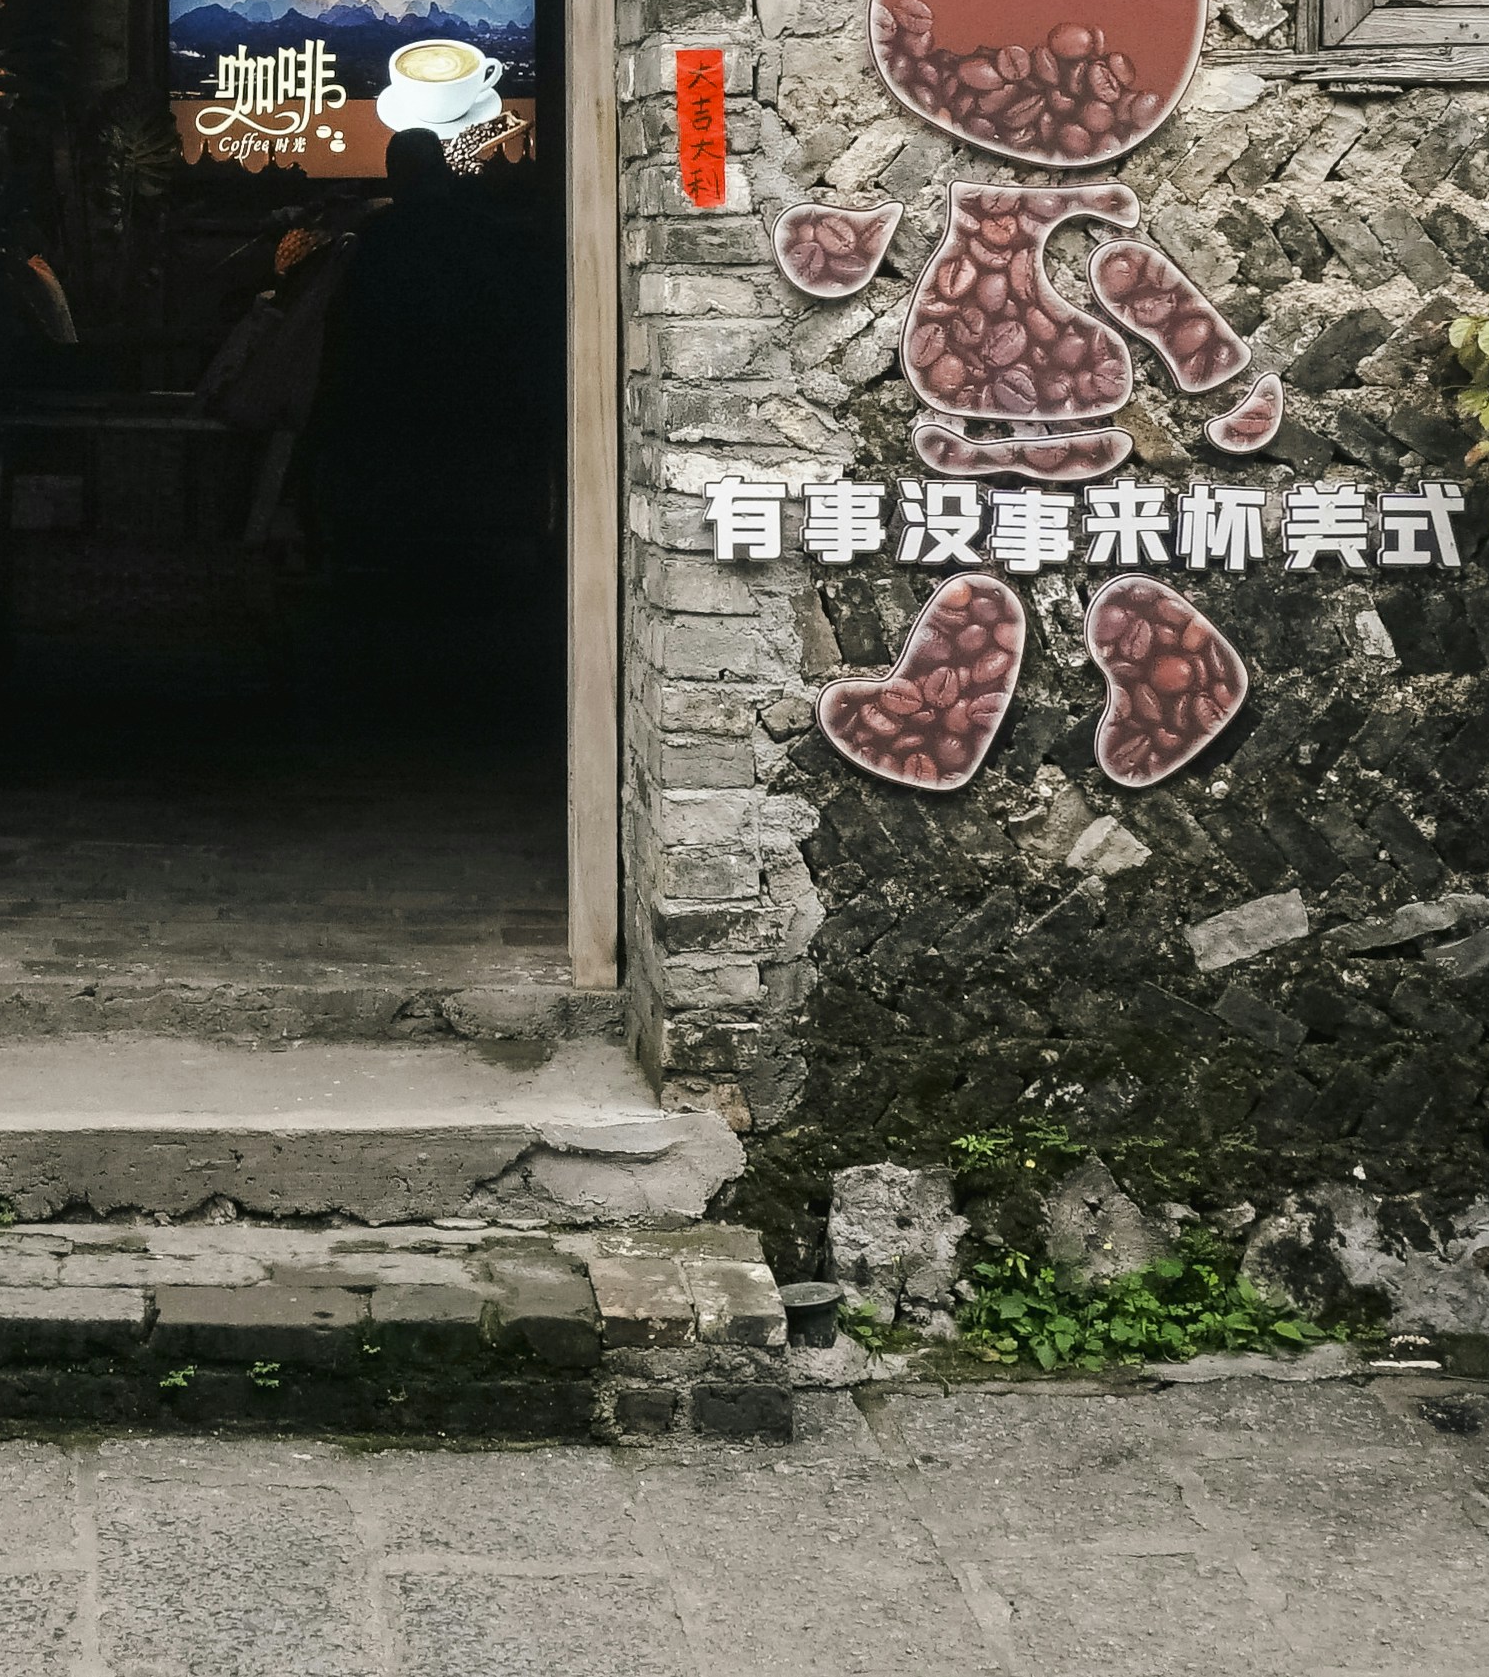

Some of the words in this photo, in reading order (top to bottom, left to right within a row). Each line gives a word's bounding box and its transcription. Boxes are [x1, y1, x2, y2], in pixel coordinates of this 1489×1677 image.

[195, 38, 347, 136] 咖啡
[687, 61, 724, 199] 大吉大利
[217, 131, 271, 161] Coffee
[704, 476, 1466, 573] 有事没事来杯美式
